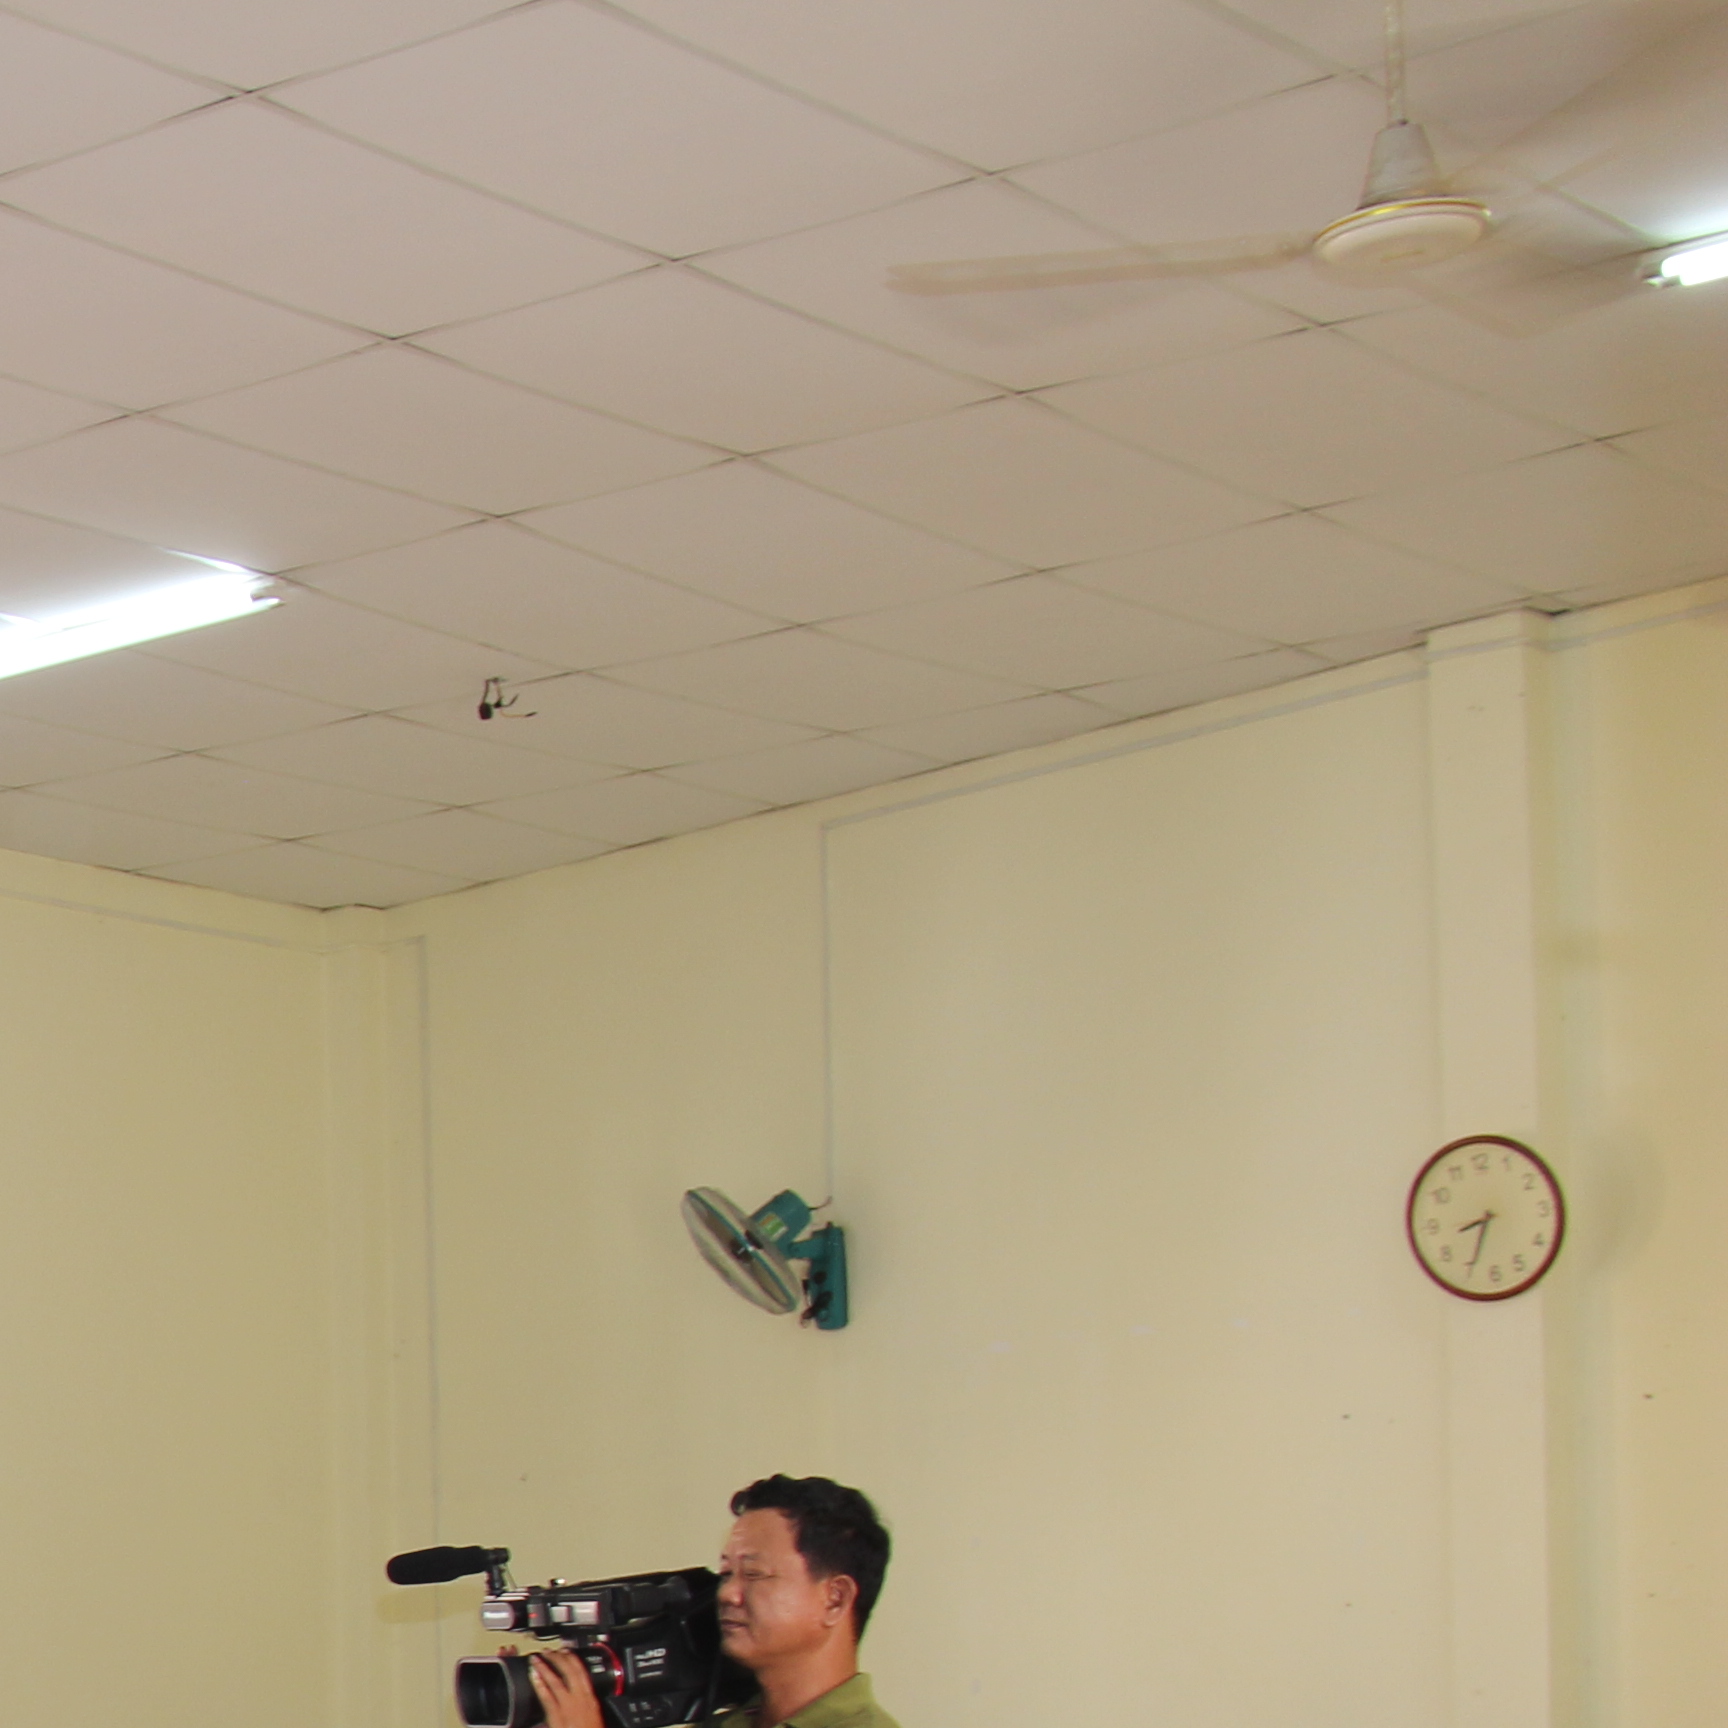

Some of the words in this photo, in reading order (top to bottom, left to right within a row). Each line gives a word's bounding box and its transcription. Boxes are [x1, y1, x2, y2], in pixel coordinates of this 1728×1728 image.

[1470, 1153, 1489, 1171] 12
[1523, 1173, 1534, 1190] 2
[1432, 1187, 1450, 1204] 10
[1538, 1200, 1549, 1217] 3
[1532, 1233, 1543, 1247] 4
[1513, 1253, 1525, 1271] 5
[1489, 1265, 1501, 1282] 6
